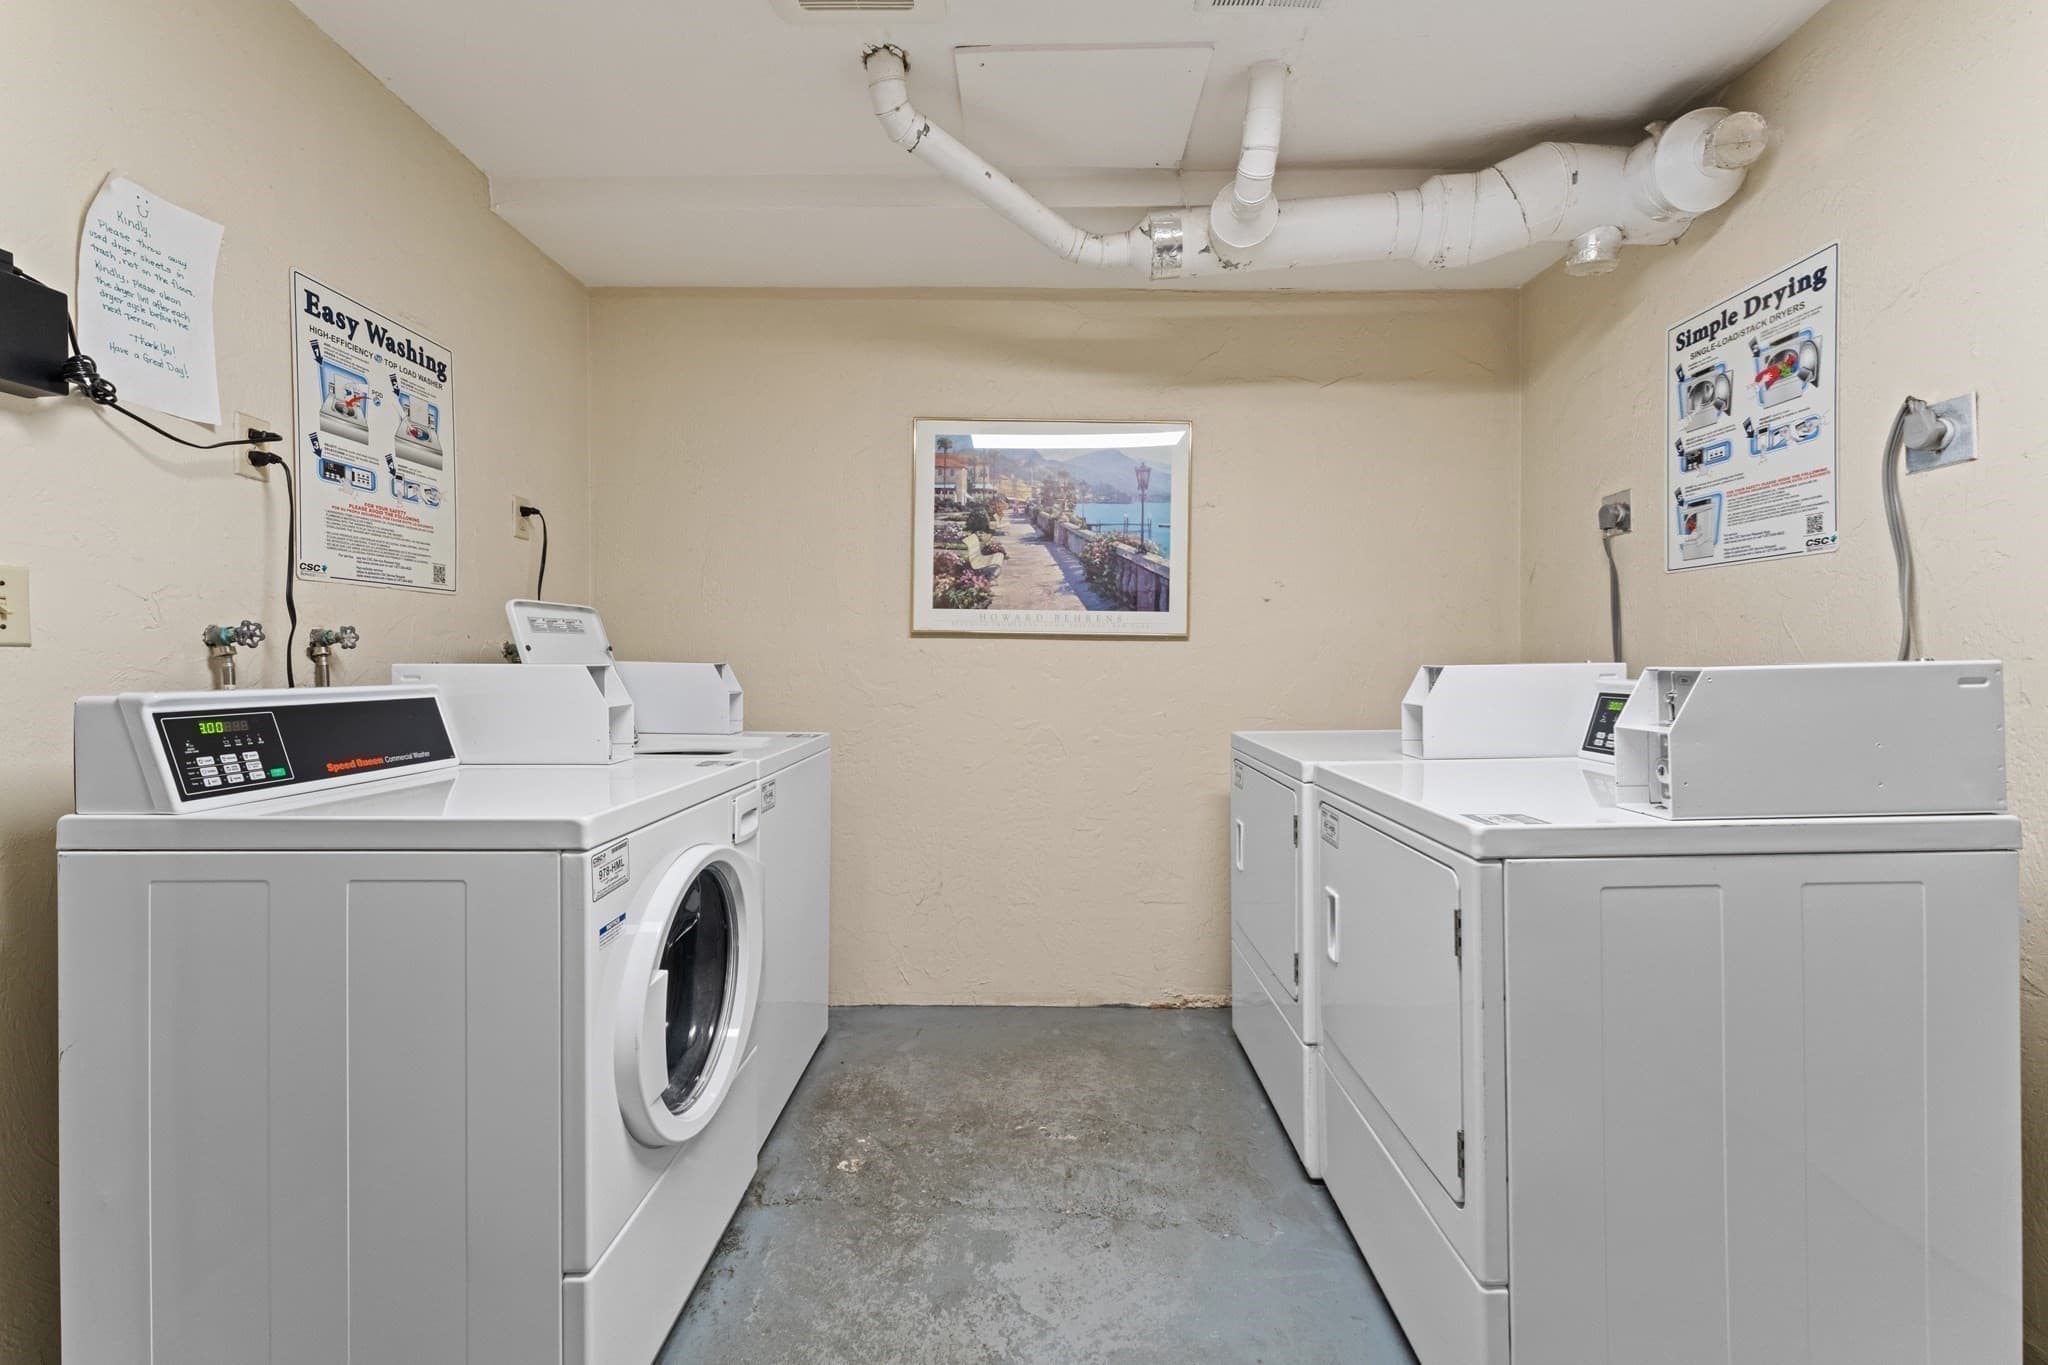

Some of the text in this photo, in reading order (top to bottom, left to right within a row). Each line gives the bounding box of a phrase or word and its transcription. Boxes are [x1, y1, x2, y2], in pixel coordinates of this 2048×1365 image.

[116, 210, 151, 238] Kindly,
[89, 230, 184, 279] used dryer sheets in
[97, 219, 187, 269] Please throw away
[95, 259, 129, 284] Kindly,
[159, 290, 182, 307] clean
[154, 273, 168, 284] the
[95, 276, 112, 288] the
[114, 283, 135, 297] dryer
[152, 300, 170, 313] after
[170, 310, 191, 323] each
[100, 289, 124, 304] dryer
[126, 301, 146, 313] cycle
[149, 307, 172, 323] before
[102, 303, 122, 316] next
[1675, 309, 1738, 351] Simple
[1743, 266, 1828, 320] Drying
[303, 288, 359, 341] Easy
[364, 318, 448, 383] Washing
[1690, 320, 1767, 361] SINGLE-LOAD/STACK
[1769, 301, 1806, 324] DRYERS
[109, 341, 129, 356] Have
[143, 353, 164, 368] Great
[166, 363, 190, 379] Day!
[309, 324, 374, 360] HIGH-EFFICIENCY
[383, 359, 398, 371] TOP
[399, 364, 417, 379] LOAD
[418, 373, 444, 391] WASHER
[348, 503, 367, 512] PLEASE
[389, 507, 407, 515] SAFETY
[1806, 537, 1829, 547] CSC
[299, 562, 321, 572] CSC
[979, 613, 1123, 624] HOWARD BEHRENS
[326, 760, 356, 773] Speed
[356, 757, 384, 767] Queen
